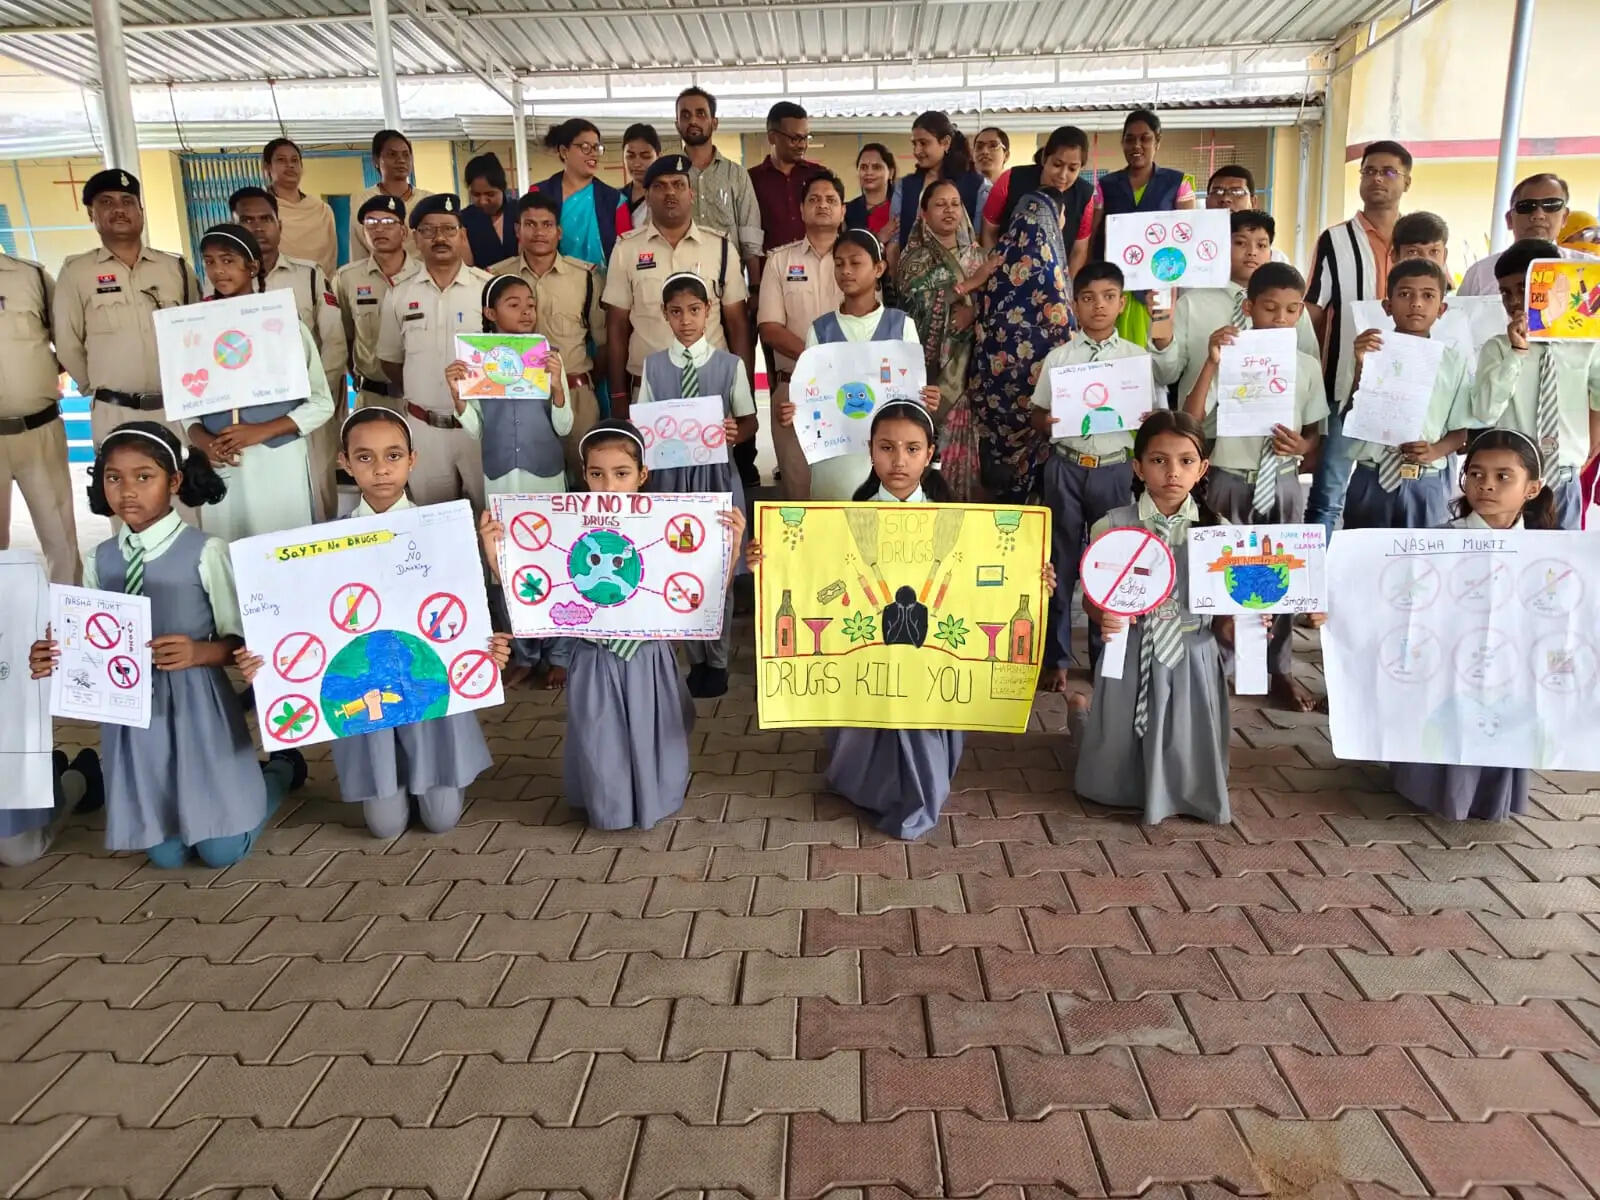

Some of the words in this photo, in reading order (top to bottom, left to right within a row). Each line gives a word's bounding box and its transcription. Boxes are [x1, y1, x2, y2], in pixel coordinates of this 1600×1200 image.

[552, 494, 591, 513] SAY
[598, 494, 622, 514] NO
[626, 494, 652, 514] TO
[582, 515, 620, 527] DRUGS
[884, 513, 929, 534] STOP
[347, 534, 378, 547] DRUGS
[1394, 539, 1445, 553] NASHA
[1462, 539, 1506, 551] MUKTI
[404, 551, 421, 562] NO
[881, 540, 935, 564] DRUGS
[250, 593, 264, 602] NO
[1196, 597, 1213, 607] NO
[765, 661, 841, 697] DRUGS
[856, 661, 908, 698] KILL
[926, 665, 973, 704] YOU
